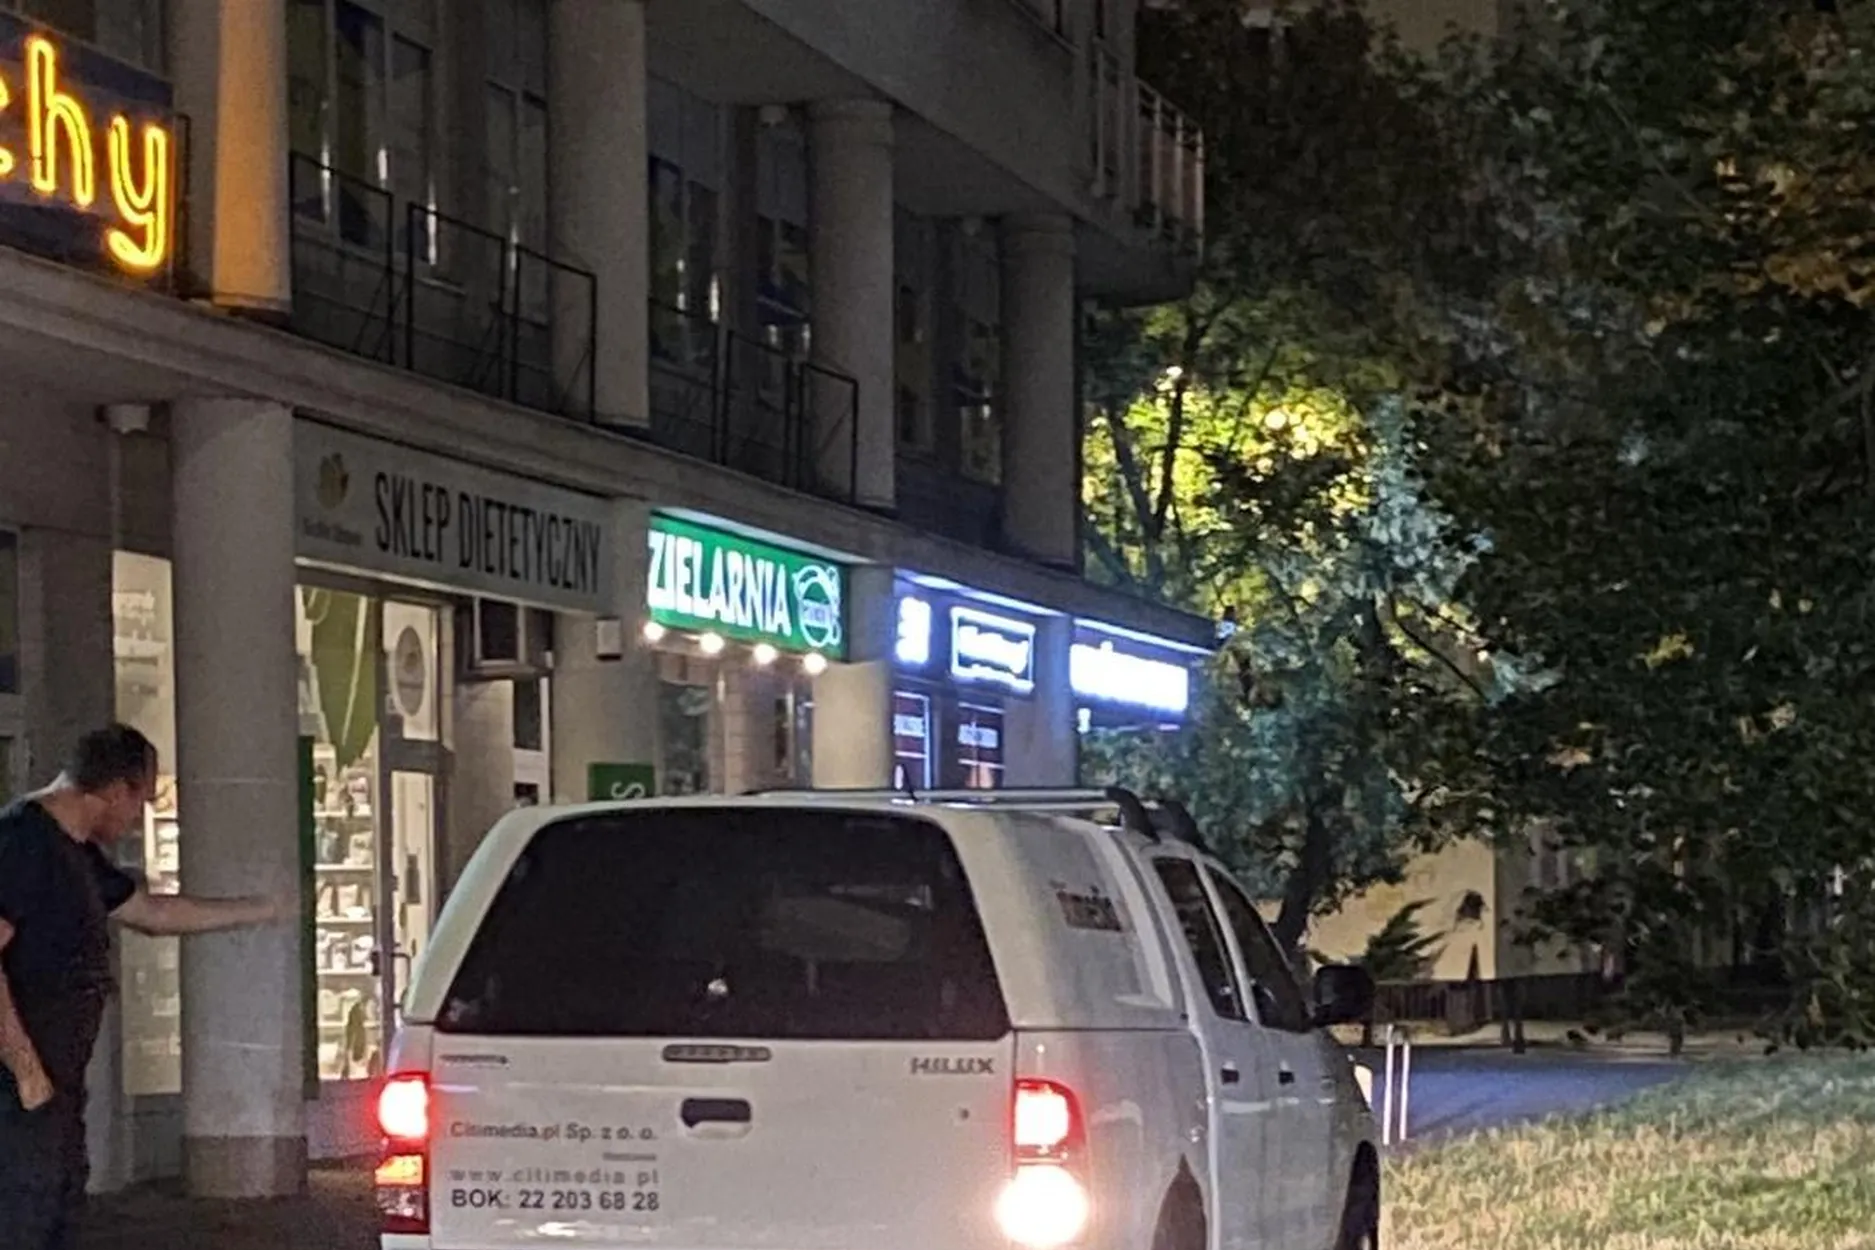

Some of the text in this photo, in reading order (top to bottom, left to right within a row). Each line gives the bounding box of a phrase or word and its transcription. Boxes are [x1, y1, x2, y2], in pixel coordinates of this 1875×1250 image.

[374, 471, 601, 594] SKLEP DIETETYCZNY
[647, 528, 793, 637] ZIELARNIA
[911, 1057, 994, 1075] HILUX
[450, 1121, 560, 1141] Citimedia.pl
[601, 1127, 612, 1140] z
[450, 1167, 659, 1187] www.citimedia.pl
[451, 1188, 660, 1211] BOK: 22 203 68 28
